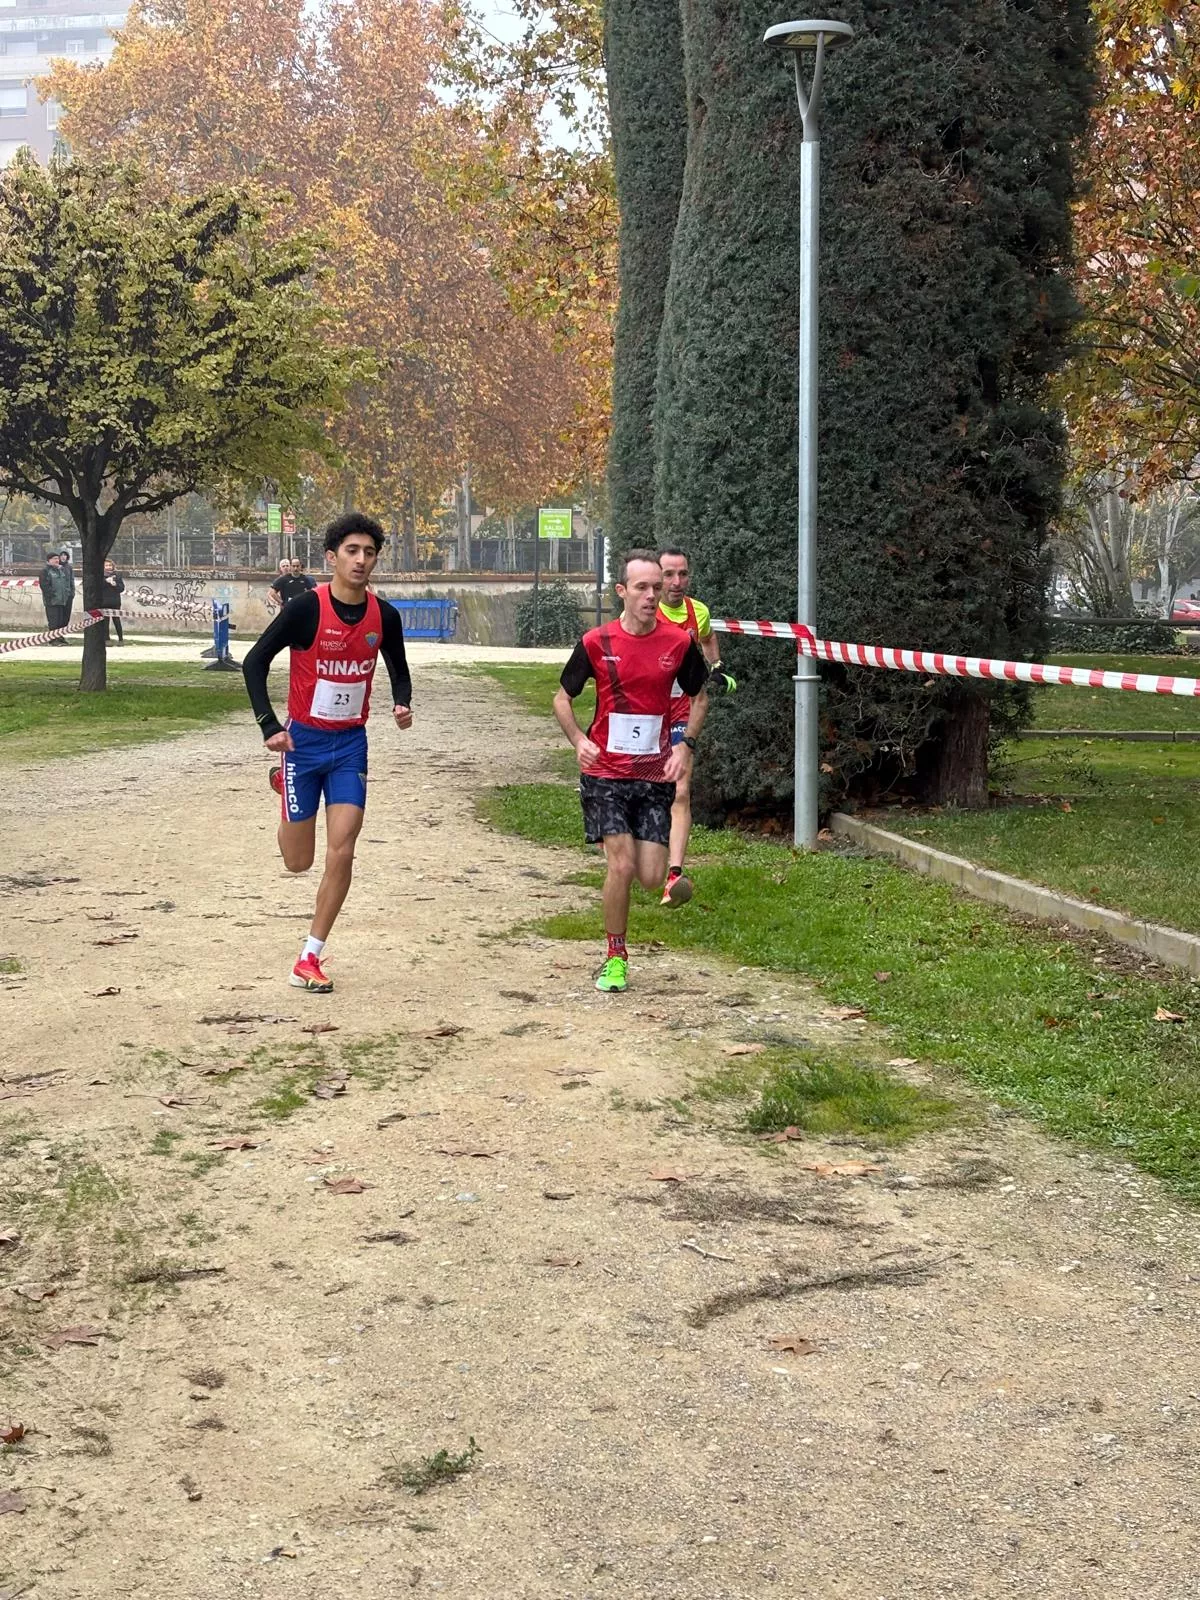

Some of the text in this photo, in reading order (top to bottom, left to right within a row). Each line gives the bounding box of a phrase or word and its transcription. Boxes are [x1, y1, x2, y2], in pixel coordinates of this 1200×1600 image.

[334, 693, 350, 705] 23
[632, 726, 640, 739] 5
[287, 763, 299, 813] hinaco
